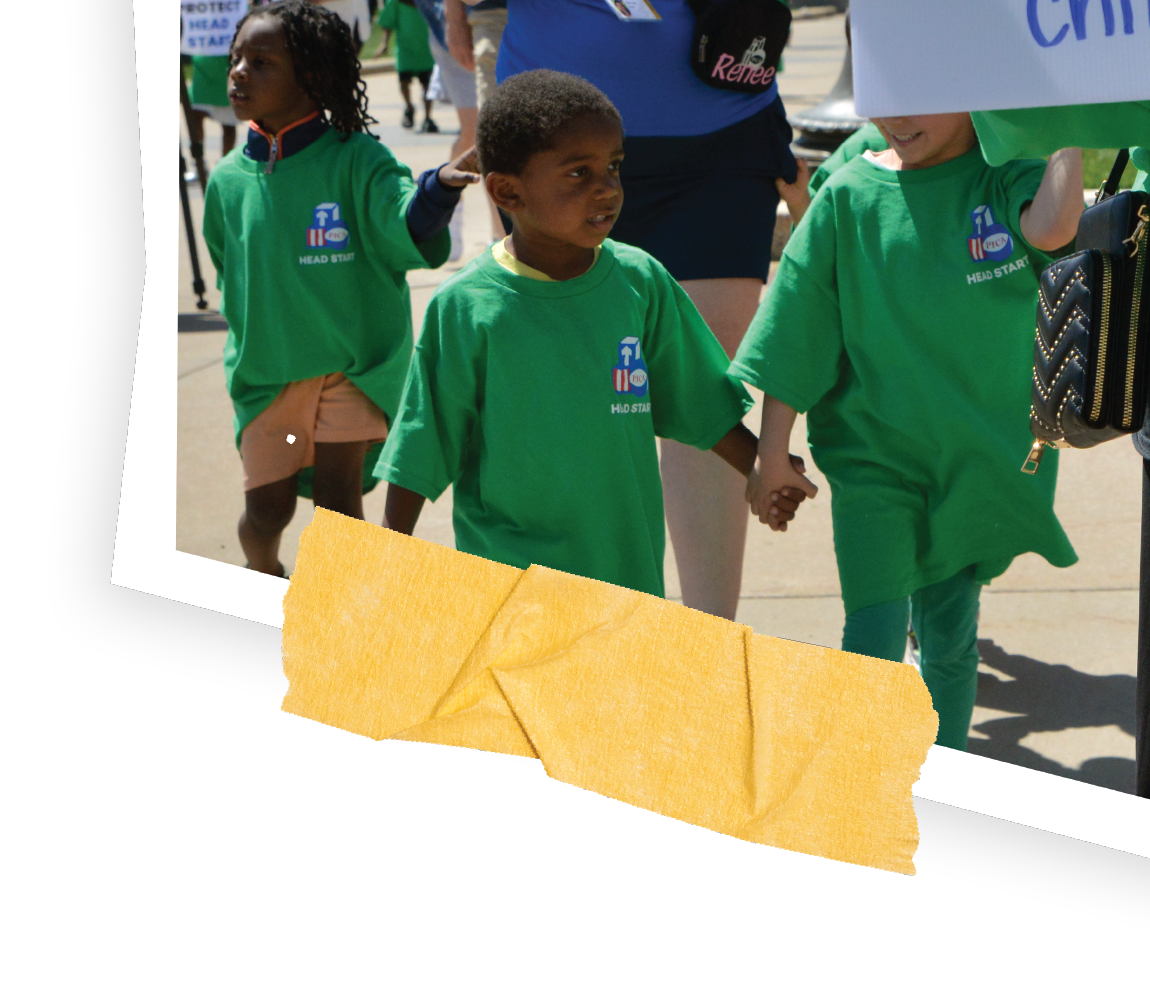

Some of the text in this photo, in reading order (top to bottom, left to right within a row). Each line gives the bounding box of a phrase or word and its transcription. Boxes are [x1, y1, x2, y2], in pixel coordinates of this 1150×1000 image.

[711, 52, 776, 85] Renee
[985, 236, 1007, 250] PICA
[299, 255, 329, 265] HEAD
[966, 254, 1030, 285] HEAD START
